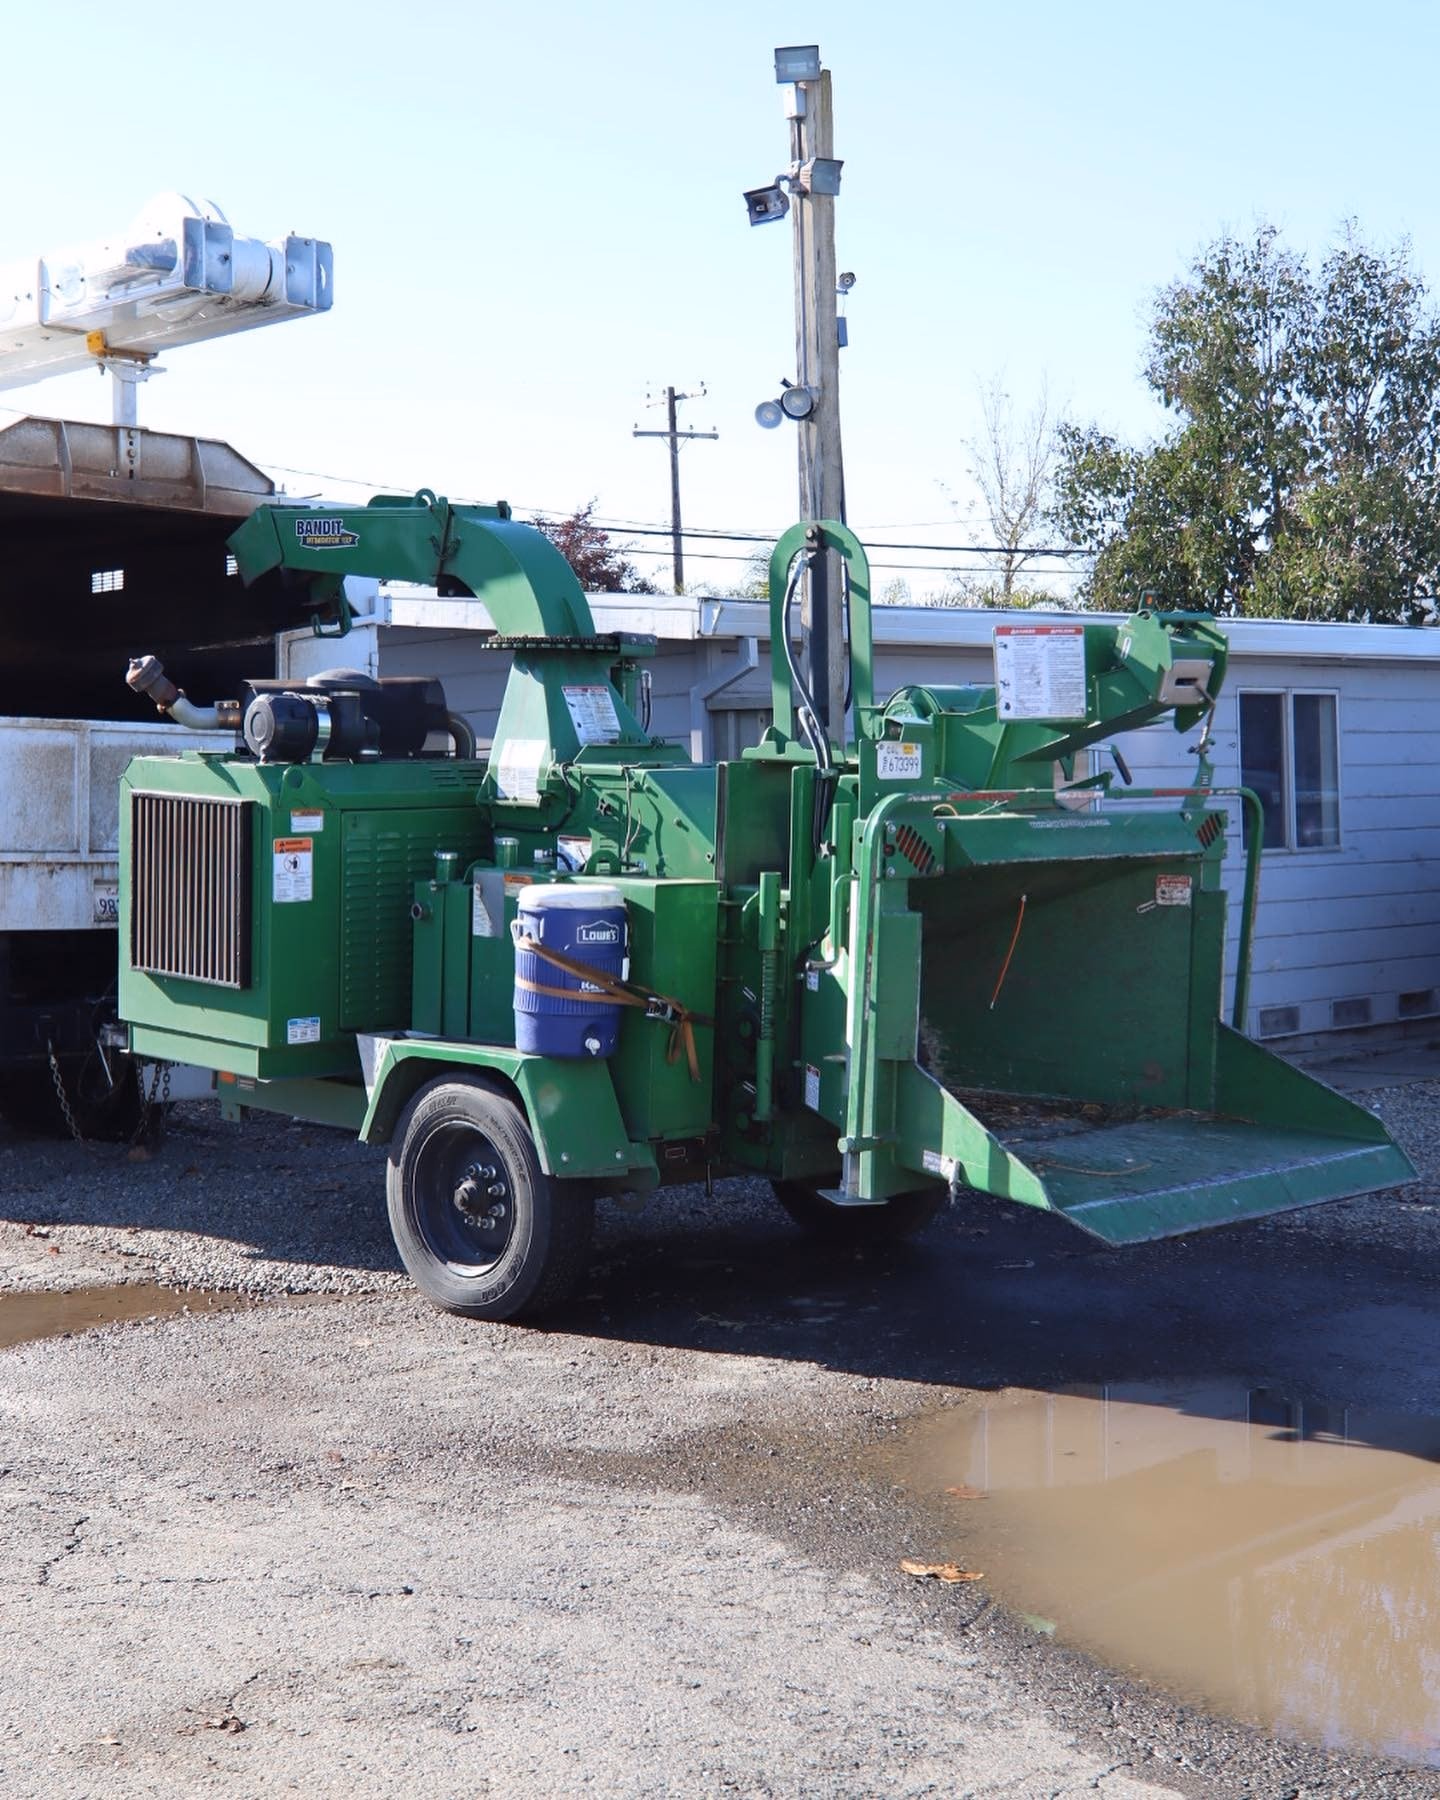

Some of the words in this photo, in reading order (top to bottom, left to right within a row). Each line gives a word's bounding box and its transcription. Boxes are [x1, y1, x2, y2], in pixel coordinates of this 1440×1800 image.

[297, 520, 342, 535] BANDIT
[99, 898, 119, 914] 98
[582, 929, 616, 941] LOWE'S
